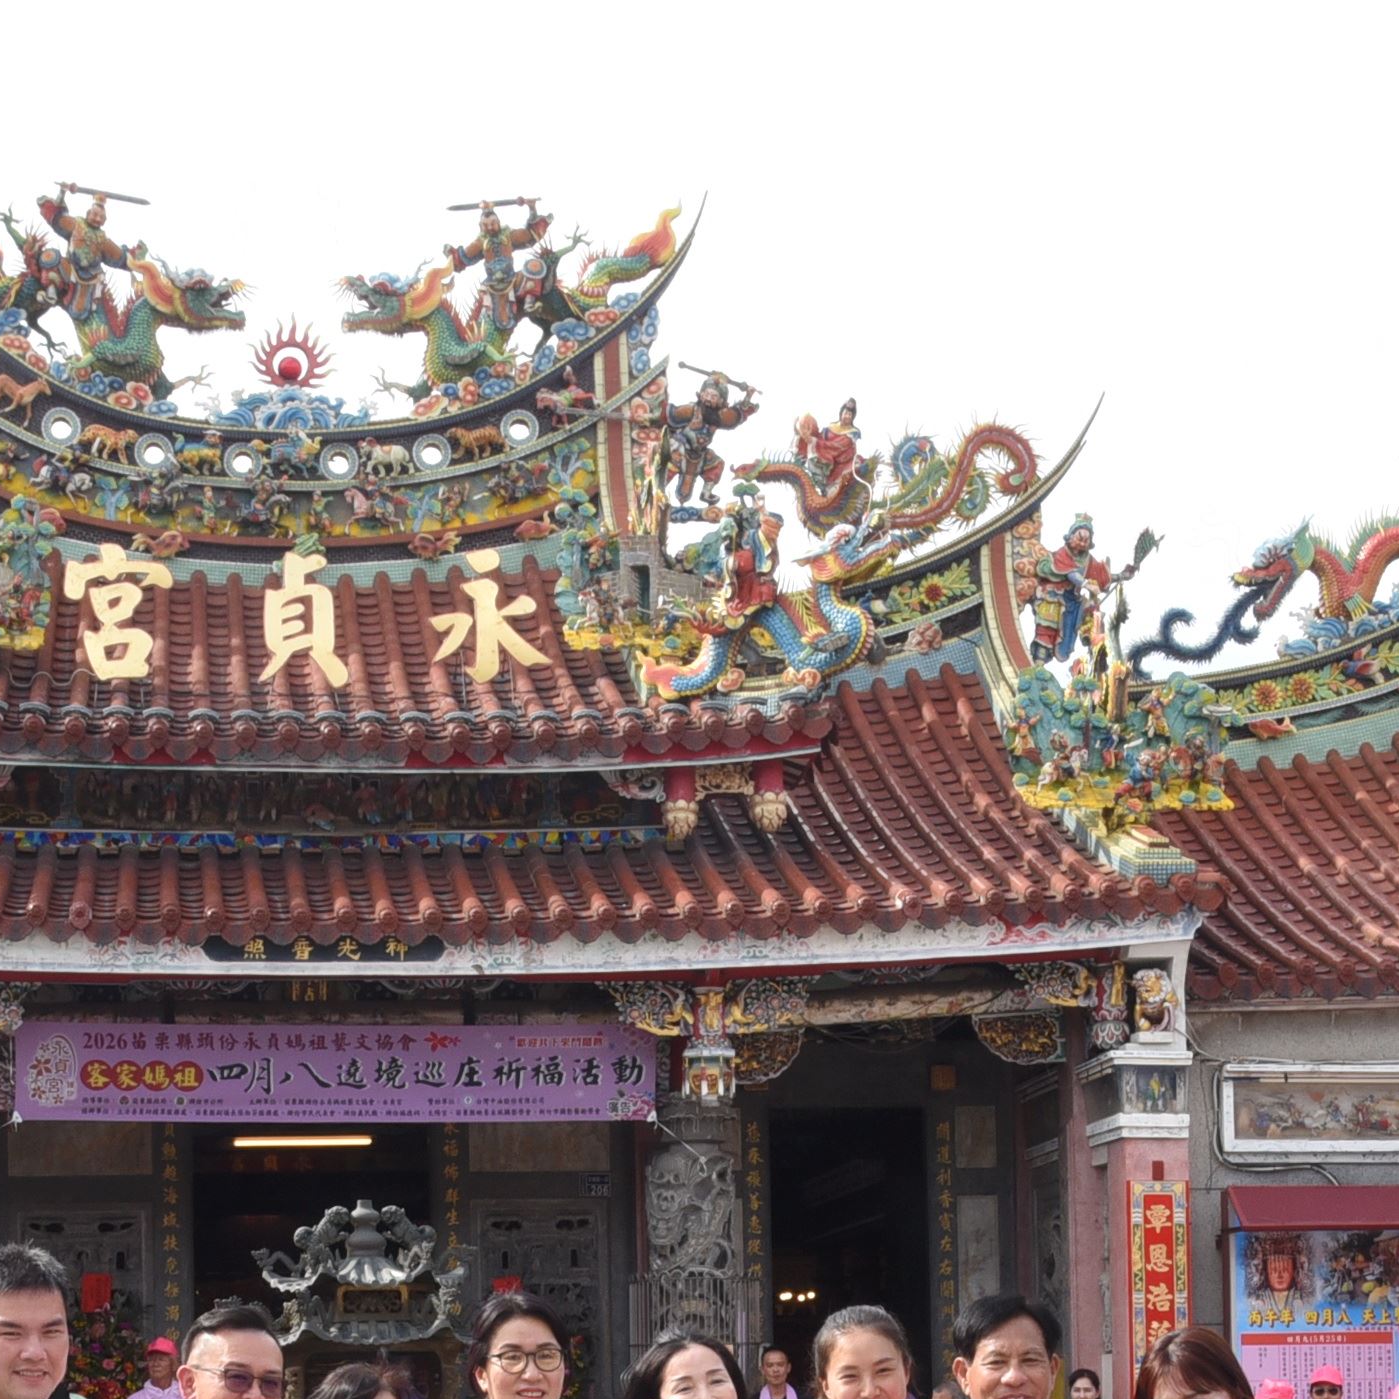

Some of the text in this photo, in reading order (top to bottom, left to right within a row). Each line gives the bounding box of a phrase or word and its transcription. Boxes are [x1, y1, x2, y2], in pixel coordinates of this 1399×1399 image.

[63, 543, 552, 687] 永貞宮
[243, 938, 409, 961] 神光普照
[86, 1061, 200, 1088] 客家媽祖
[1248, 1308, 1295, 1327] 丙午年
[1304, 1308, 1352, 1327] 四月八
